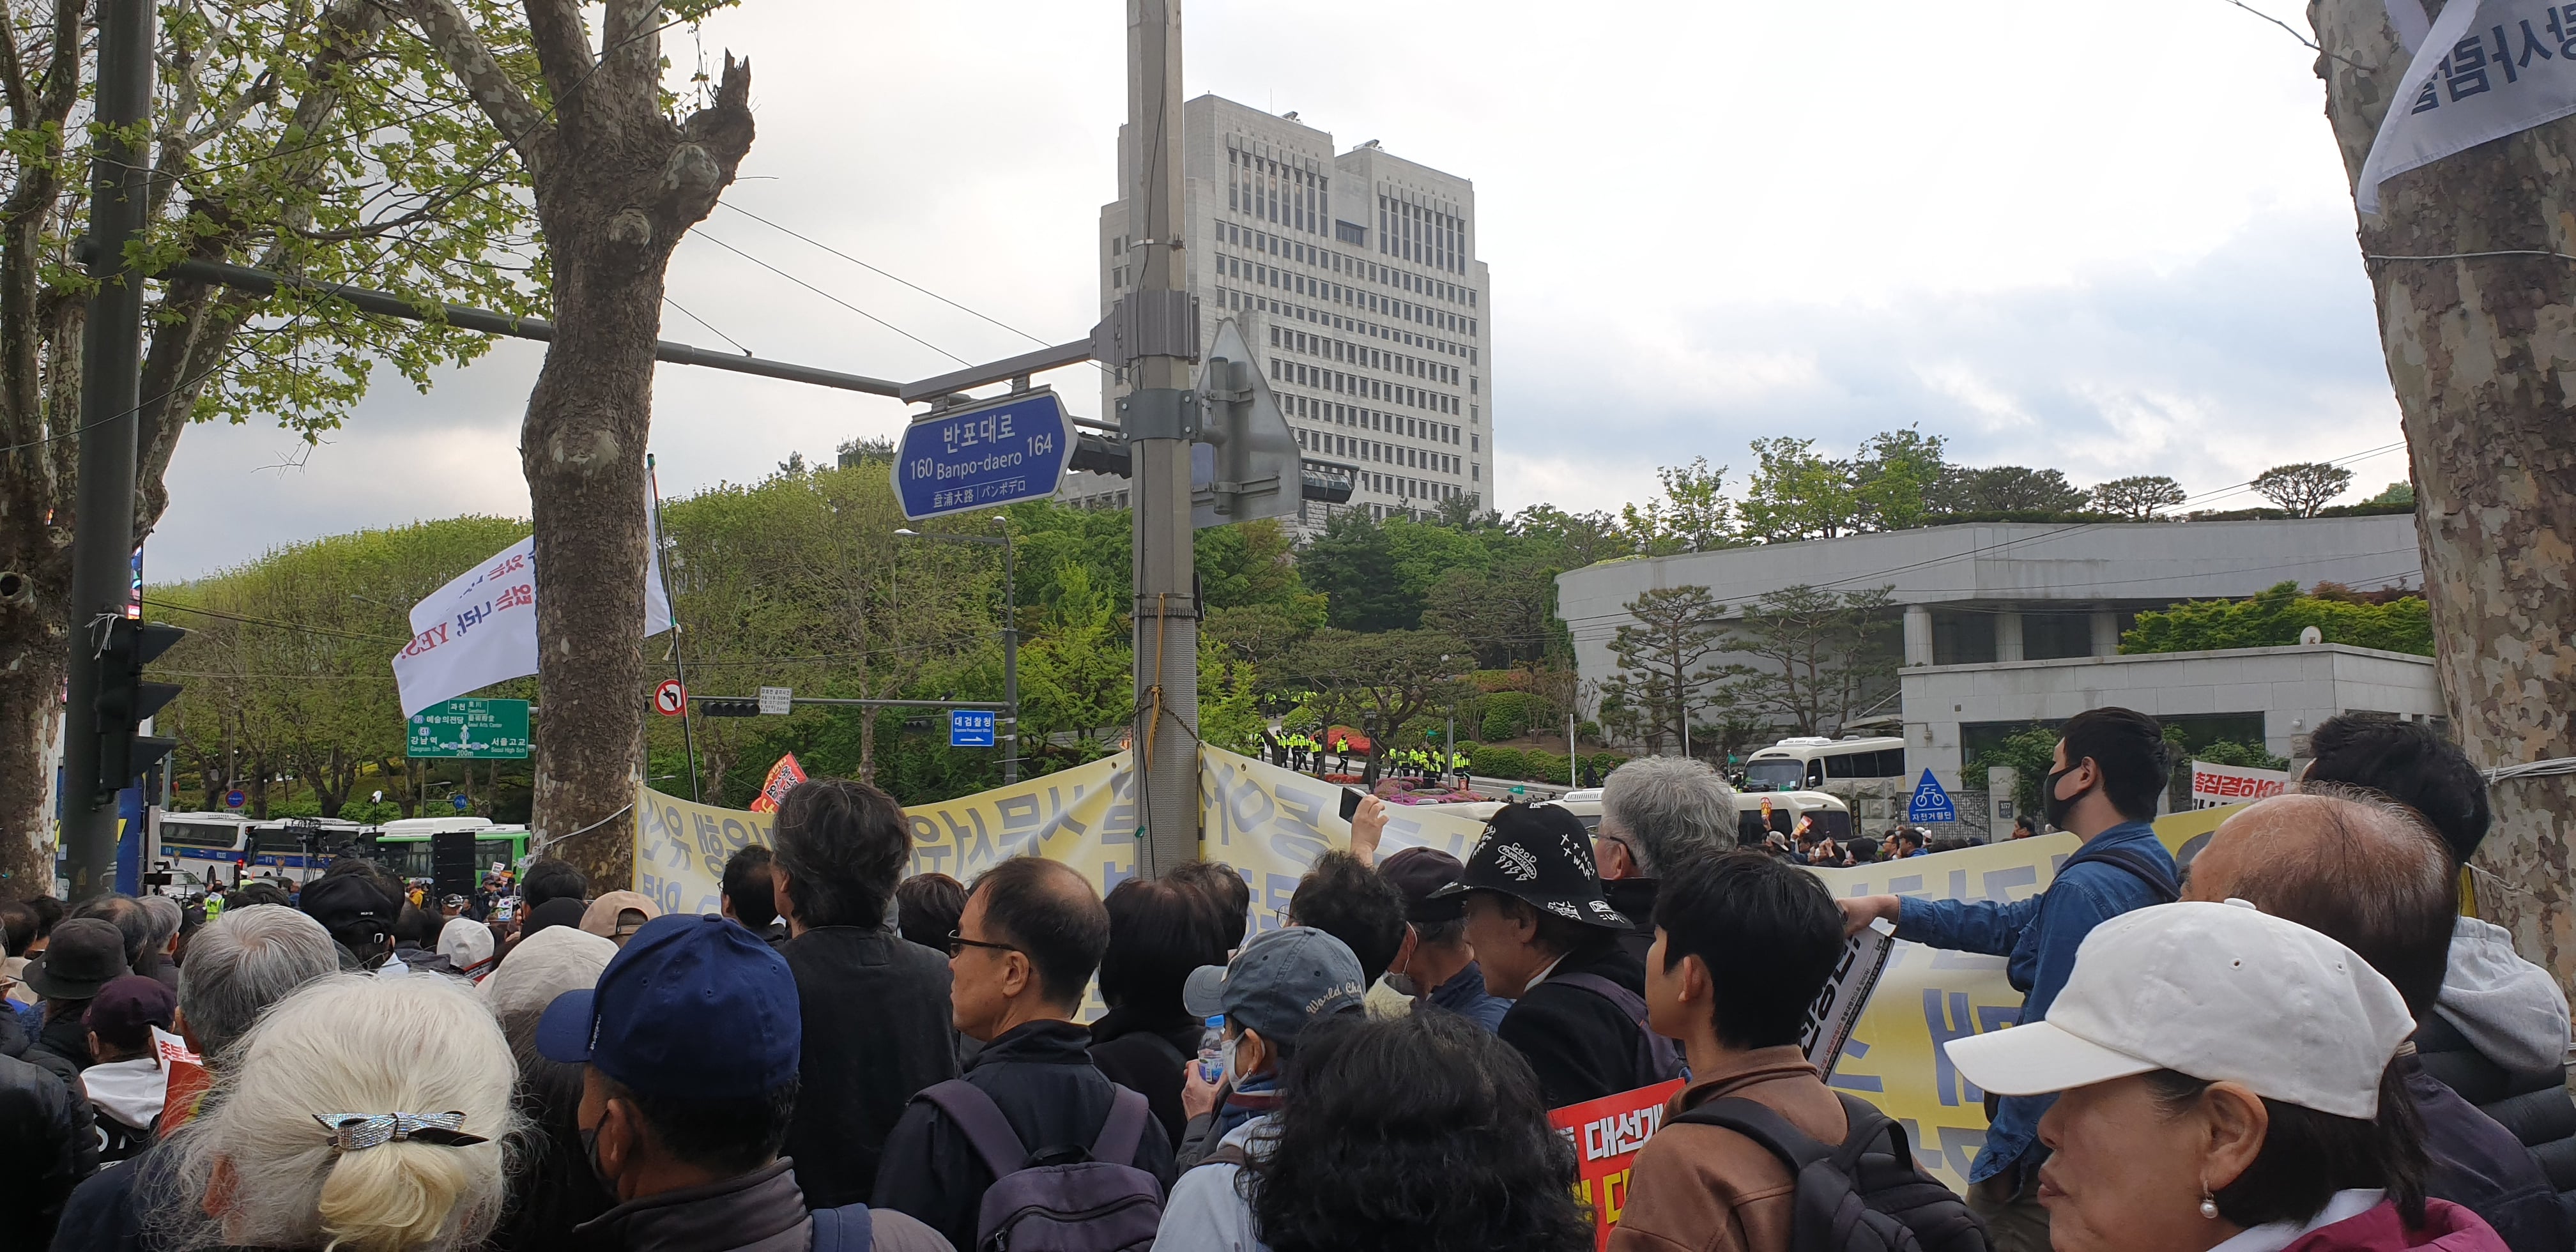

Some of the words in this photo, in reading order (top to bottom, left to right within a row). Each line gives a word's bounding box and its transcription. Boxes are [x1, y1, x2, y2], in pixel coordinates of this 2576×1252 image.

[944, 415, 1015, 454] 반포대로
[910, 457, 933, 480] 160
[937, 451, 1022, 480] Banpo-daero
[1027, 432, 1053, 457] 164
[981, 480, 1026, 498] パンポデロ
[450, 703, 466, 711] 과천
[426, 715, 464, 724] 예술의전당
[954, 716, 991, 727] 대검찰청
[410, 737, 438, 745] 강남역
[491, 737, 526, 746] 서울고교
[1912, 811, 1952, 821] 자전거횡단
[1512, 843, 1537, 863] GOOD
[1502, 846, 1535, 878] PANAVISION
[1305, 984, 1342, 1014] World
